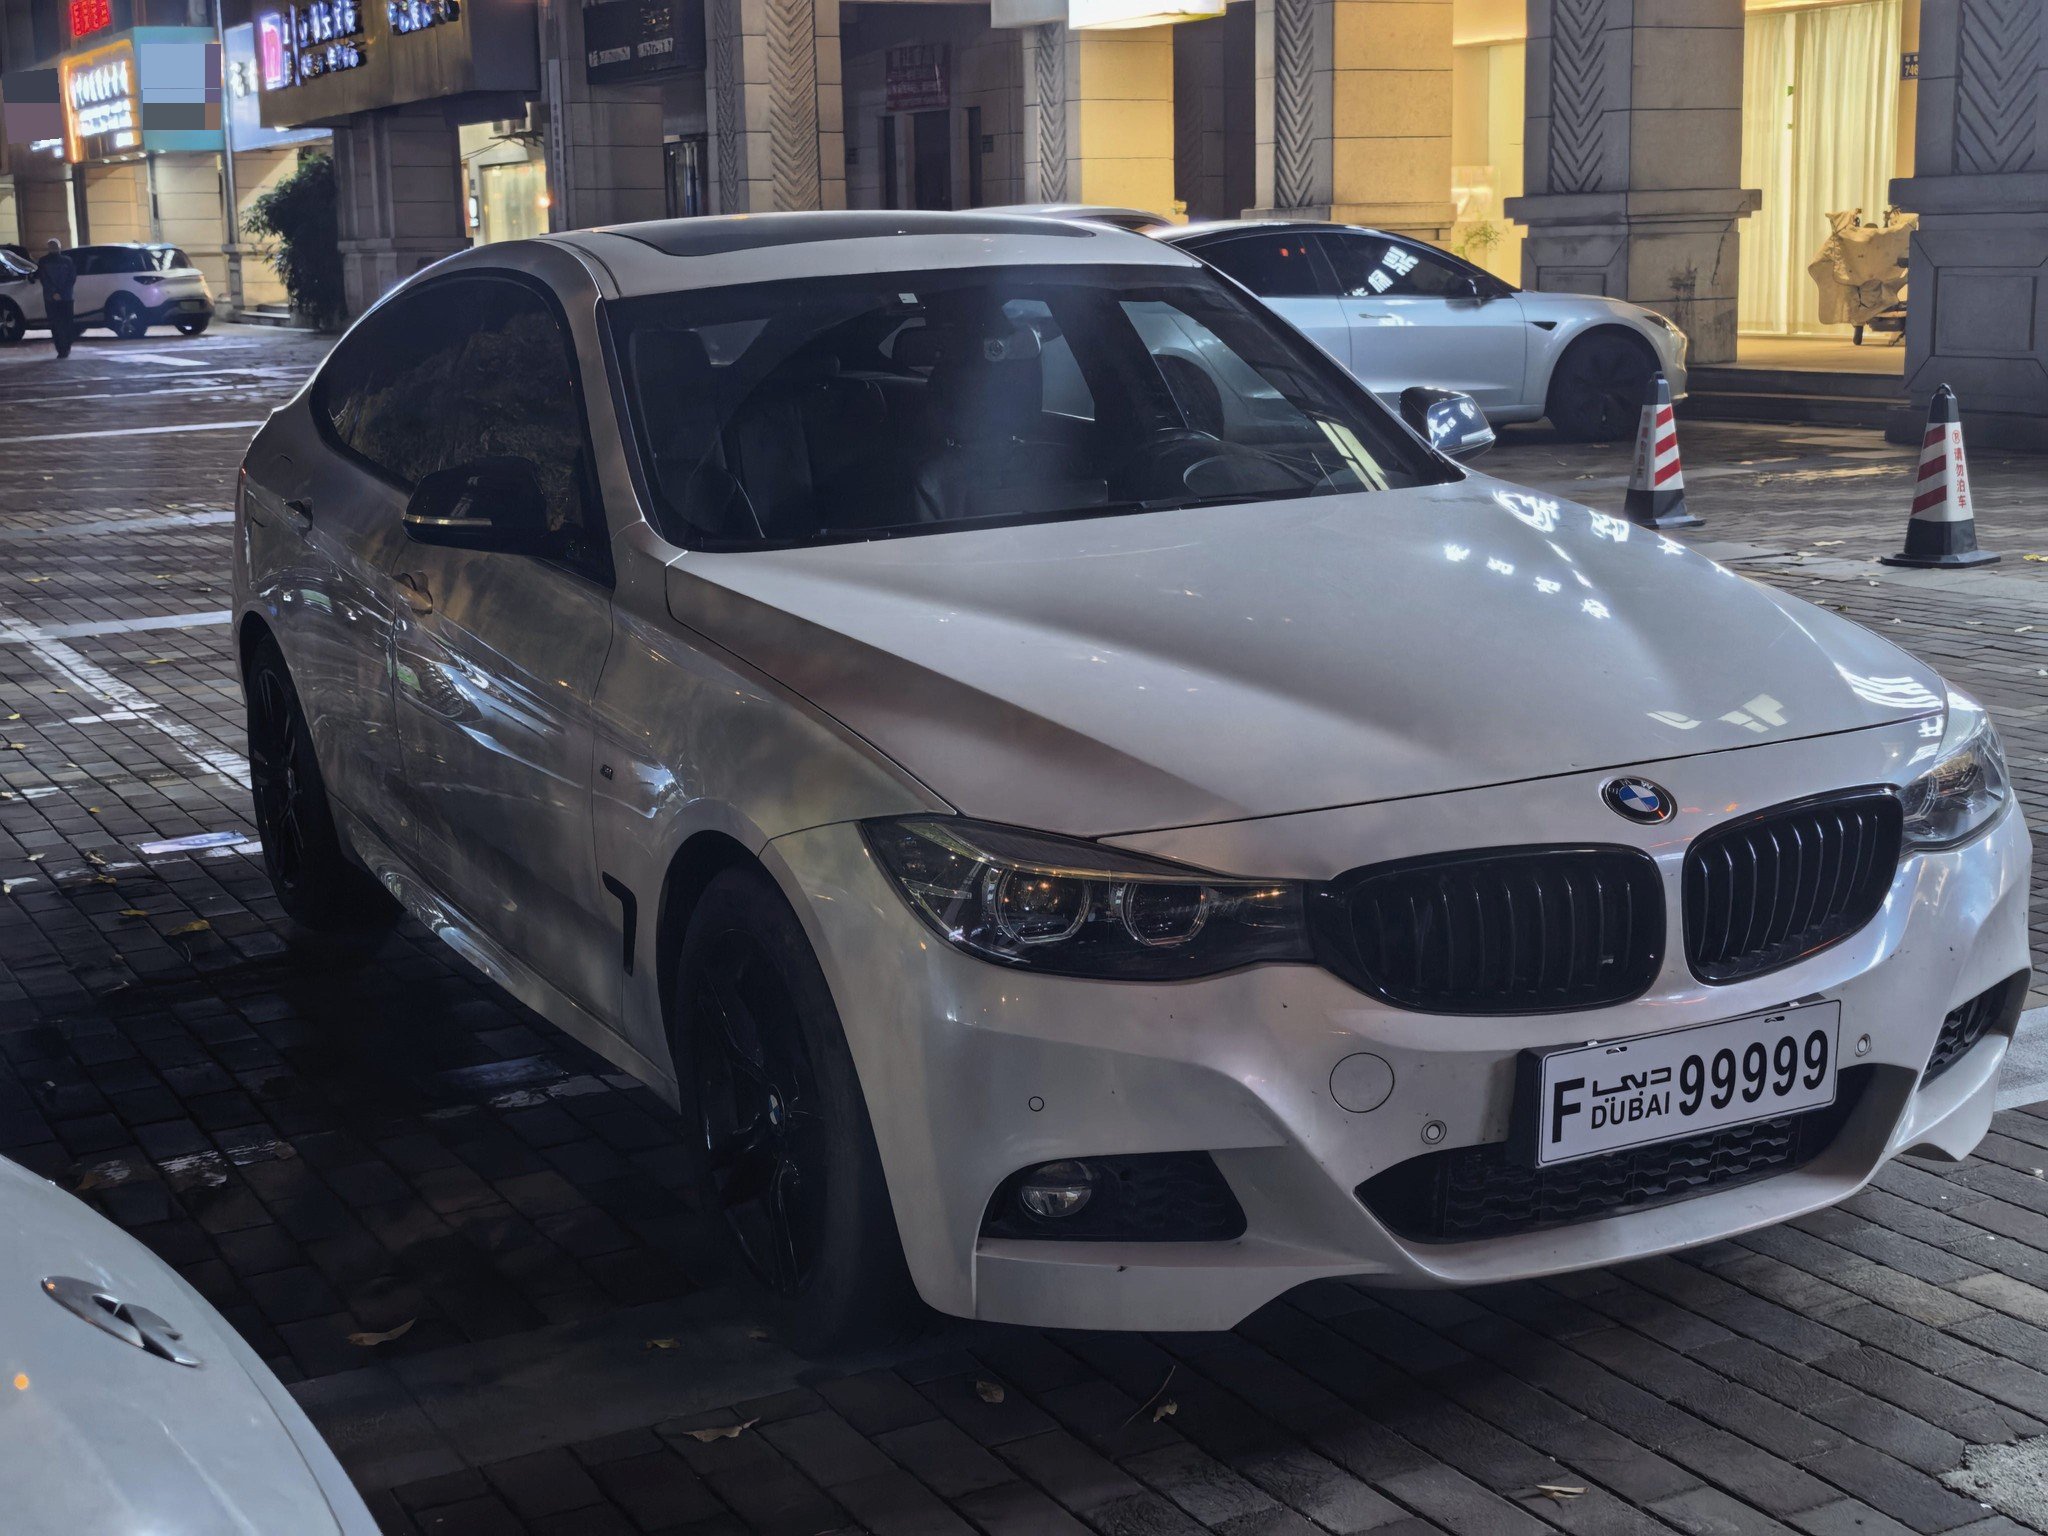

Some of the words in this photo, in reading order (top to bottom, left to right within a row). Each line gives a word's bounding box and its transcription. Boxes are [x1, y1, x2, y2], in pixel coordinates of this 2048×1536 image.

[1954, 447, 1967, 508] 请勿泊车
[1679, 1029, 1829, 1117] 99999
[1552, 1077, 1585, 1144] F
[1591, 1091, 1670, 1130] DUBAI
